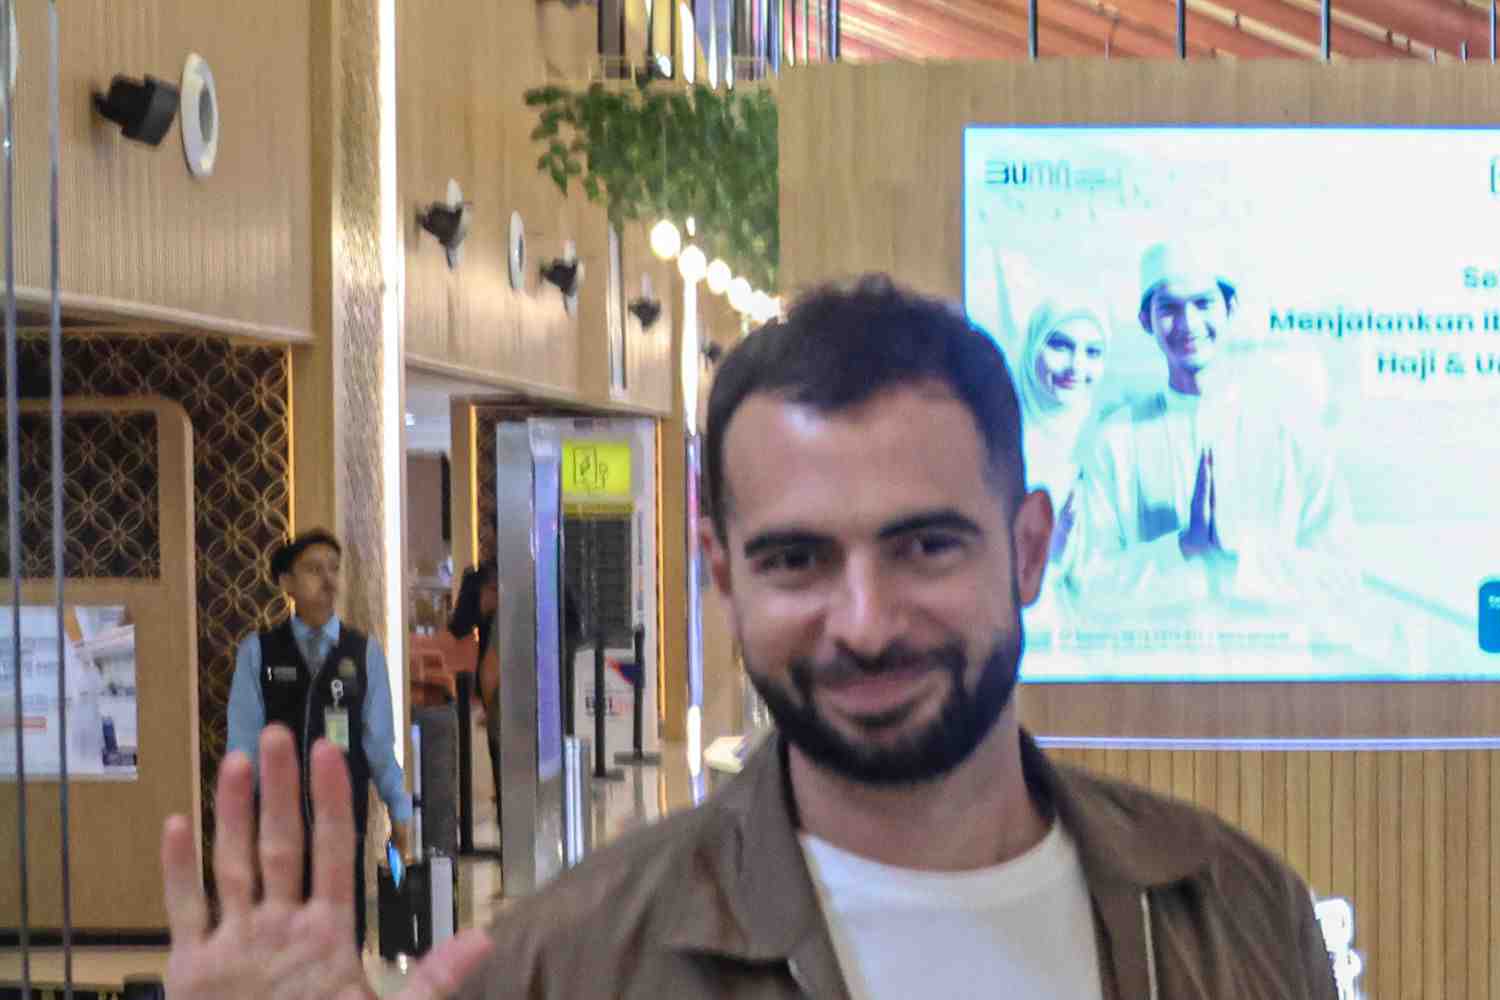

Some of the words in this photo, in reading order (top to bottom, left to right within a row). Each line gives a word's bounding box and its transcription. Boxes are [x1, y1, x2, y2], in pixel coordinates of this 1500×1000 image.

[1269, 305, 1475, 340] Menjalankan
[1377, 351, 1437, 380] Haji
[1444, 353, 1465, 375] &
